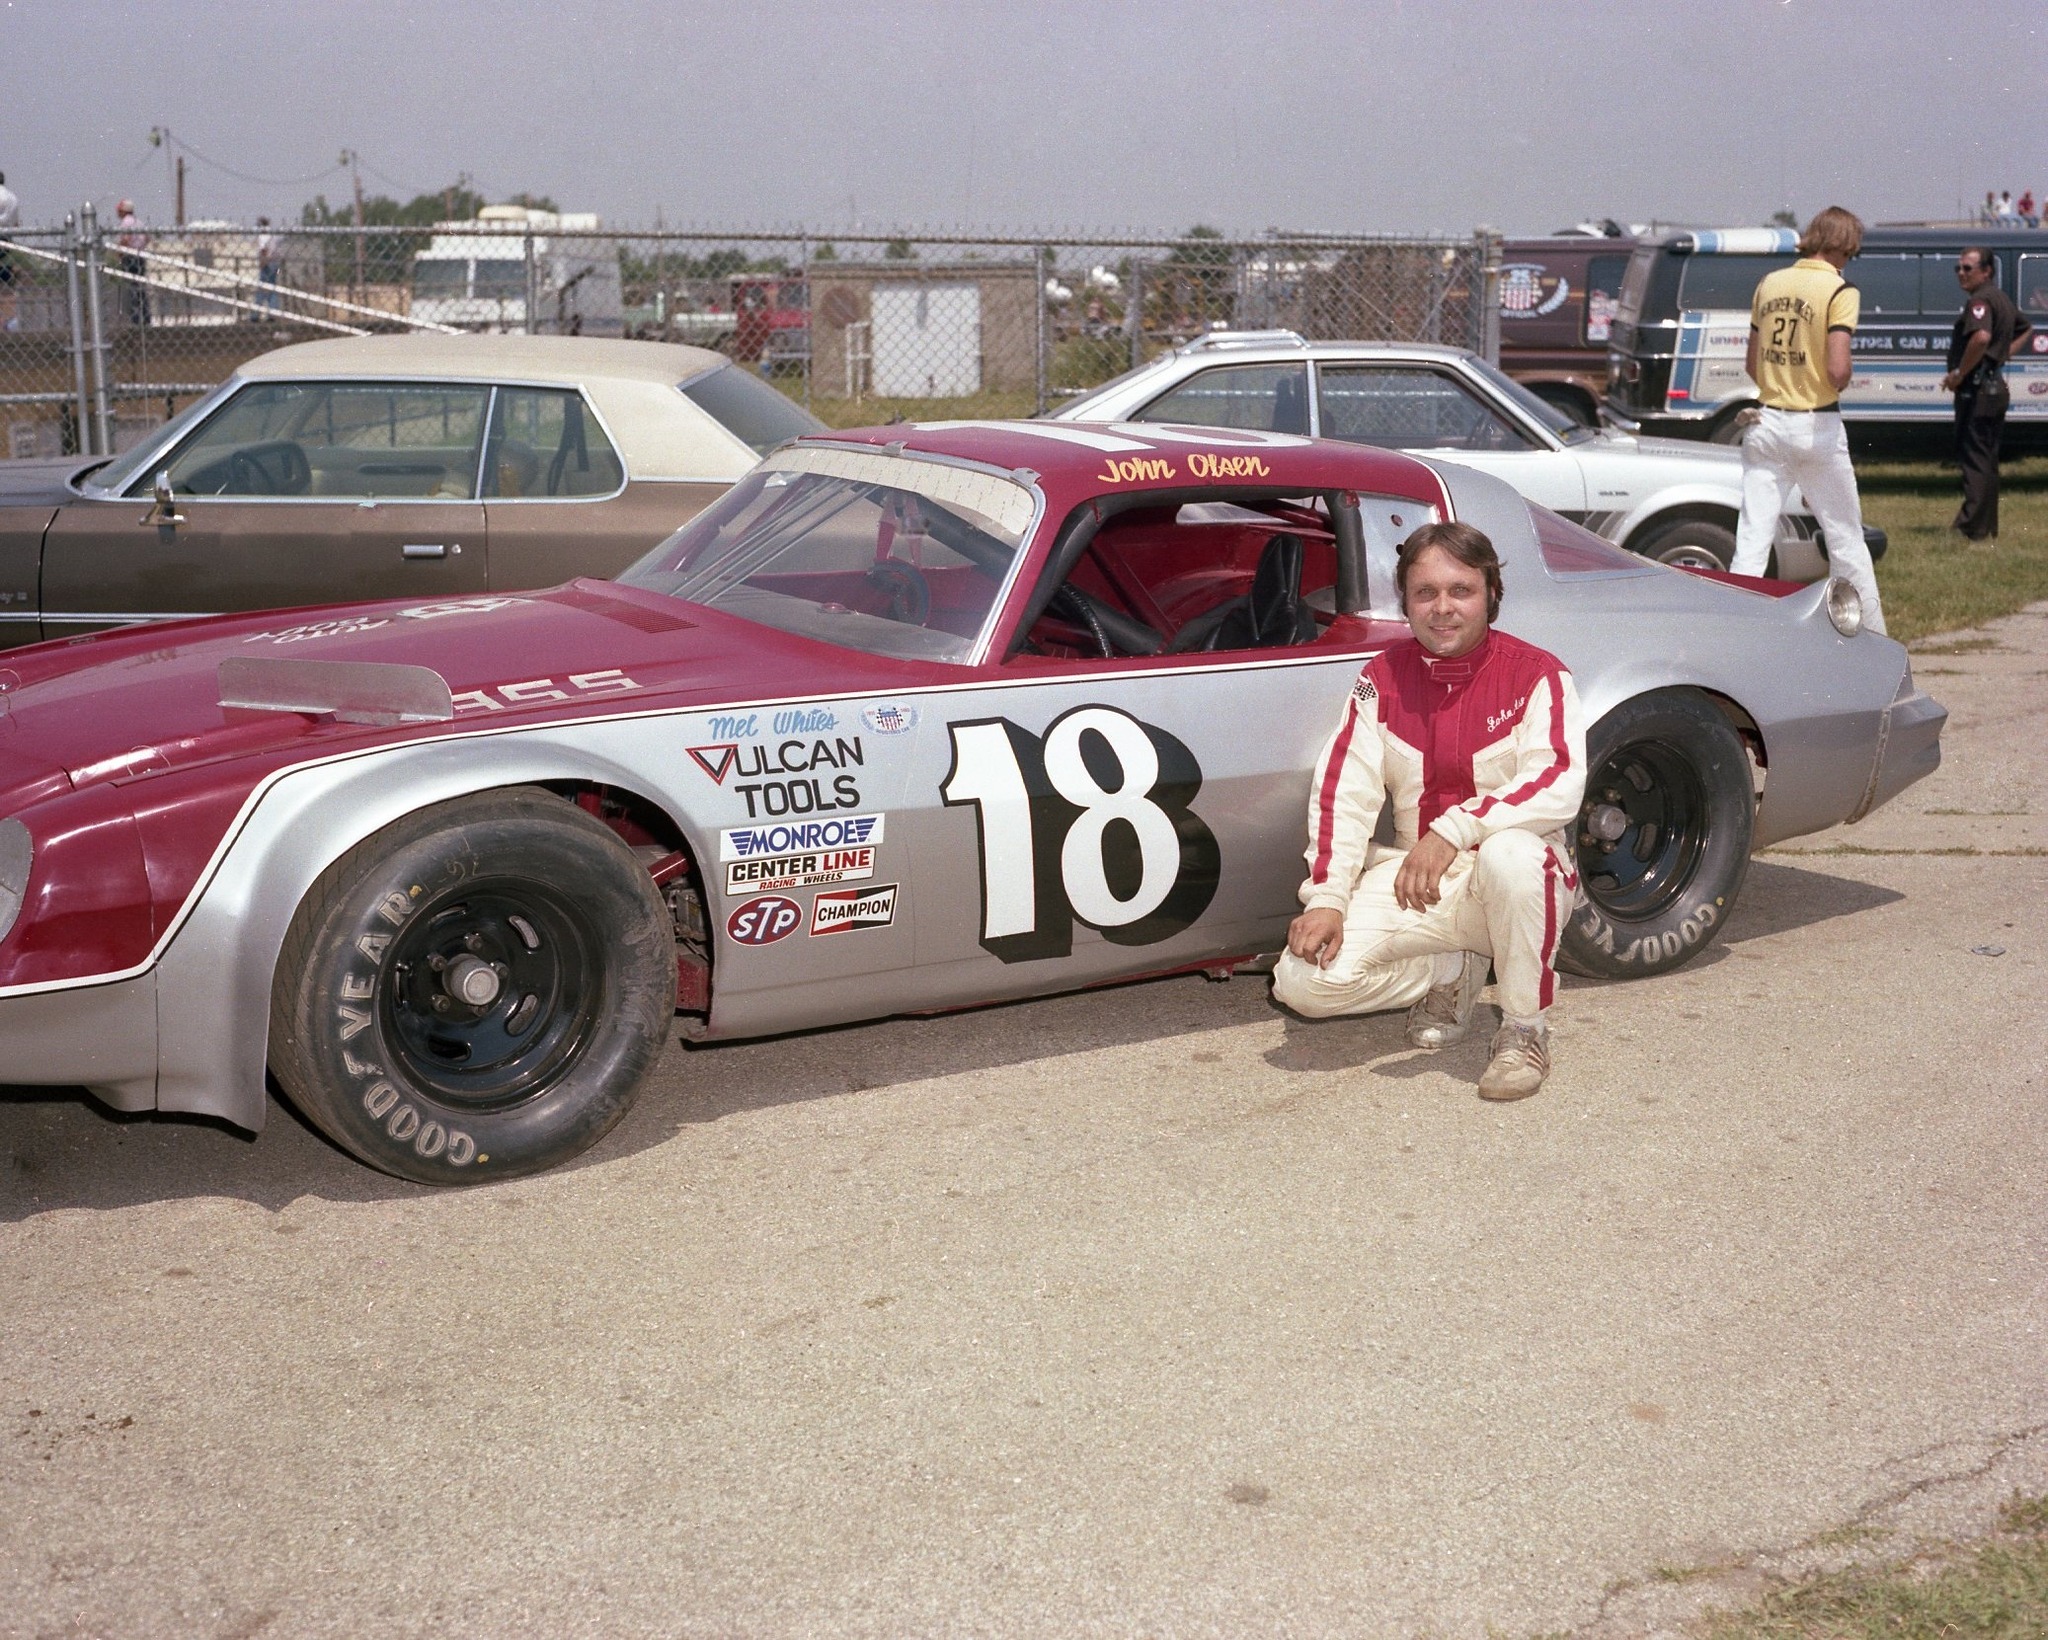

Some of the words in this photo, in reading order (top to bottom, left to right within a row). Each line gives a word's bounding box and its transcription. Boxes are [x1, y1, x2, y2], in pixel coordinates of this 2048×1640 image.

[1772, 317, 1799, 347] 27
[1851, 336, 1893, 350] STOCK
[1899, 336, 1927, 350] CAR
[1097, 456, 1177, 484] John
[1187, 452, 1271, 479] Olsen
[273, 618, 389, 644] AUTO
[708, 714, 759, 740] Mel
[687, 737, 864, 781] VULCAN
[734, 775, 861, 818] TOOLS
[747, 820, 858, 855] MONROE
[940, 703, 1210, 957] 18
[732, 855, 817, 882] CENTER
[822, 849, 871, 872] LINE
[758, 877, 797, 891] RACING
[803, 871, 844, 885] WHEELS
[733, 900, 797, 940] STP
[817, 899, 892, 922] CHAMPION
